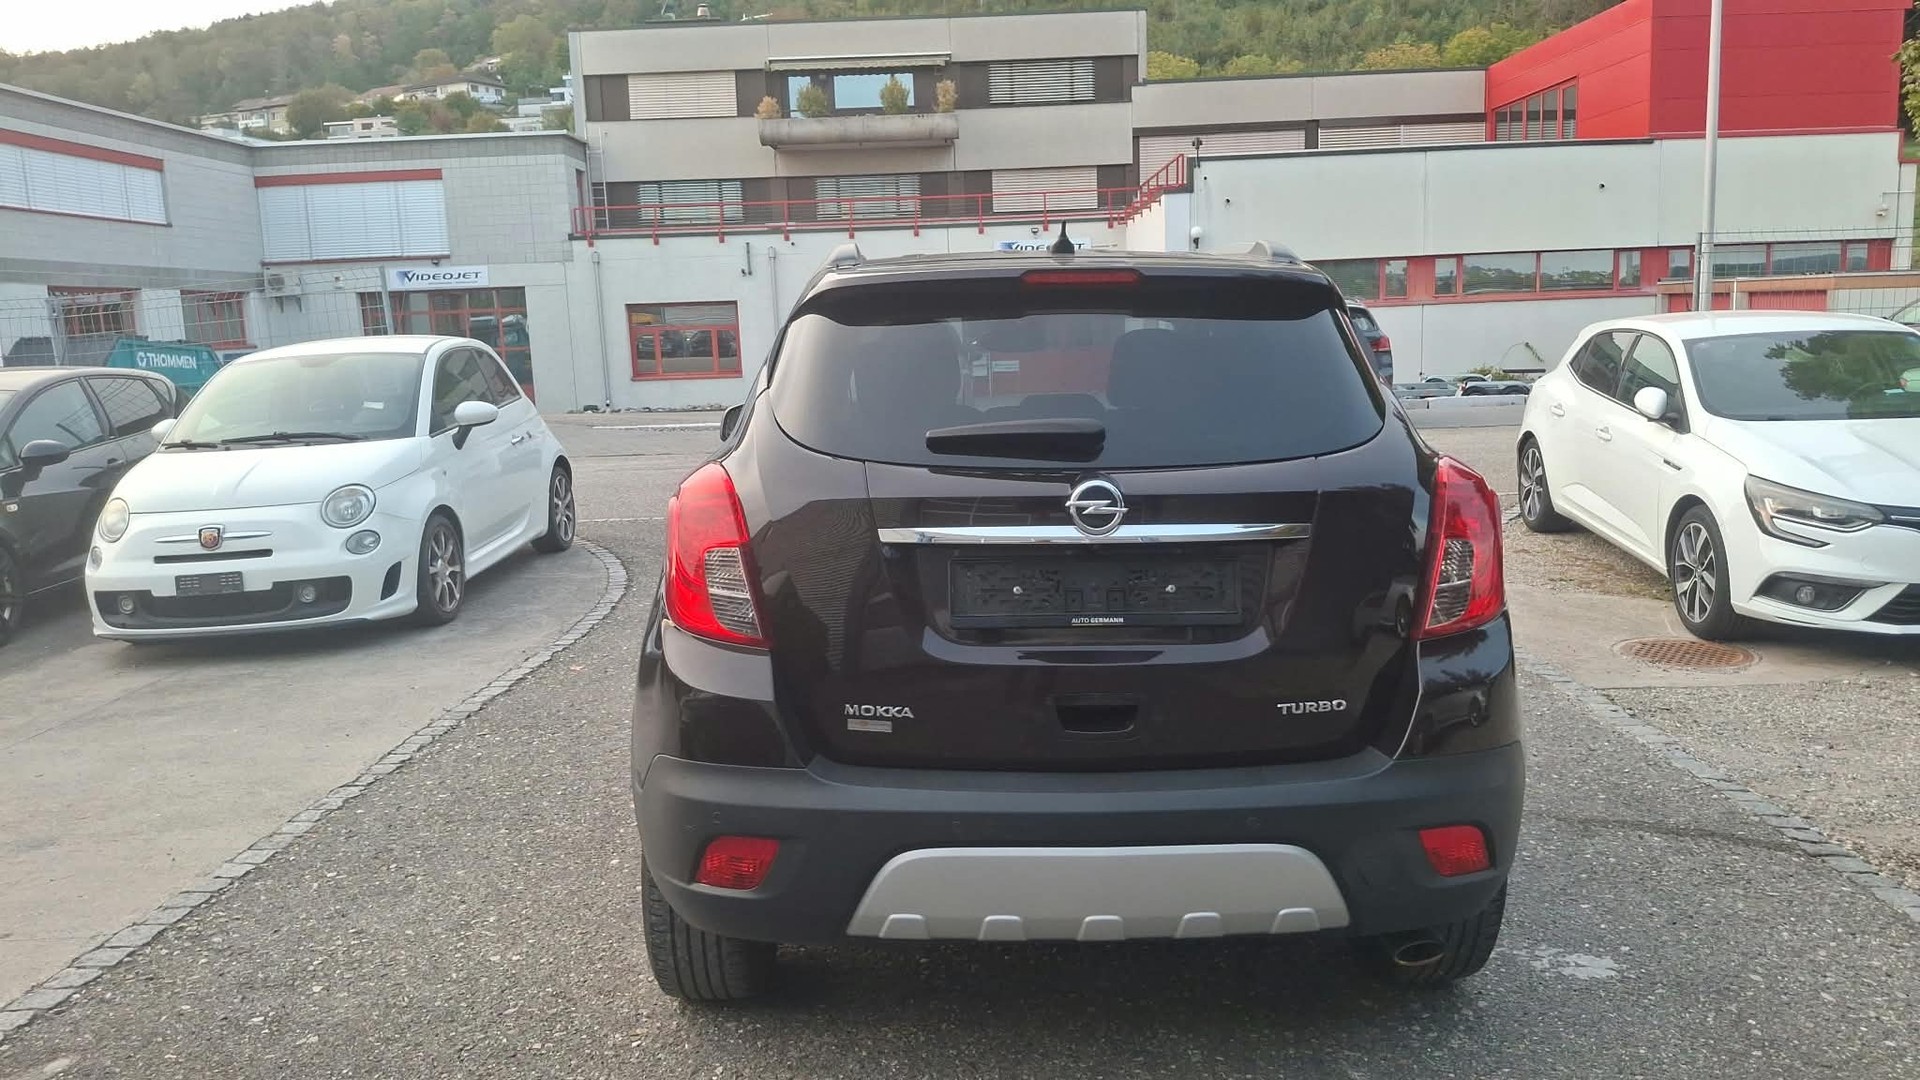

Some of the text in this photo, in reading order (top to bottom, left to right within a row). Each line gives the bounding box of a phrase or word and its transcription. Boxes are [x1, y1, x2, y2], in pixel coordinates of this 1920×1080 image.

[402, 270, 482, 283] VIDEOJET
[146, 352, 197, 370] THOMMEN
[844, 704, 914, 718] MOKKA
[1277, 699, 1347, 715] TURBO
